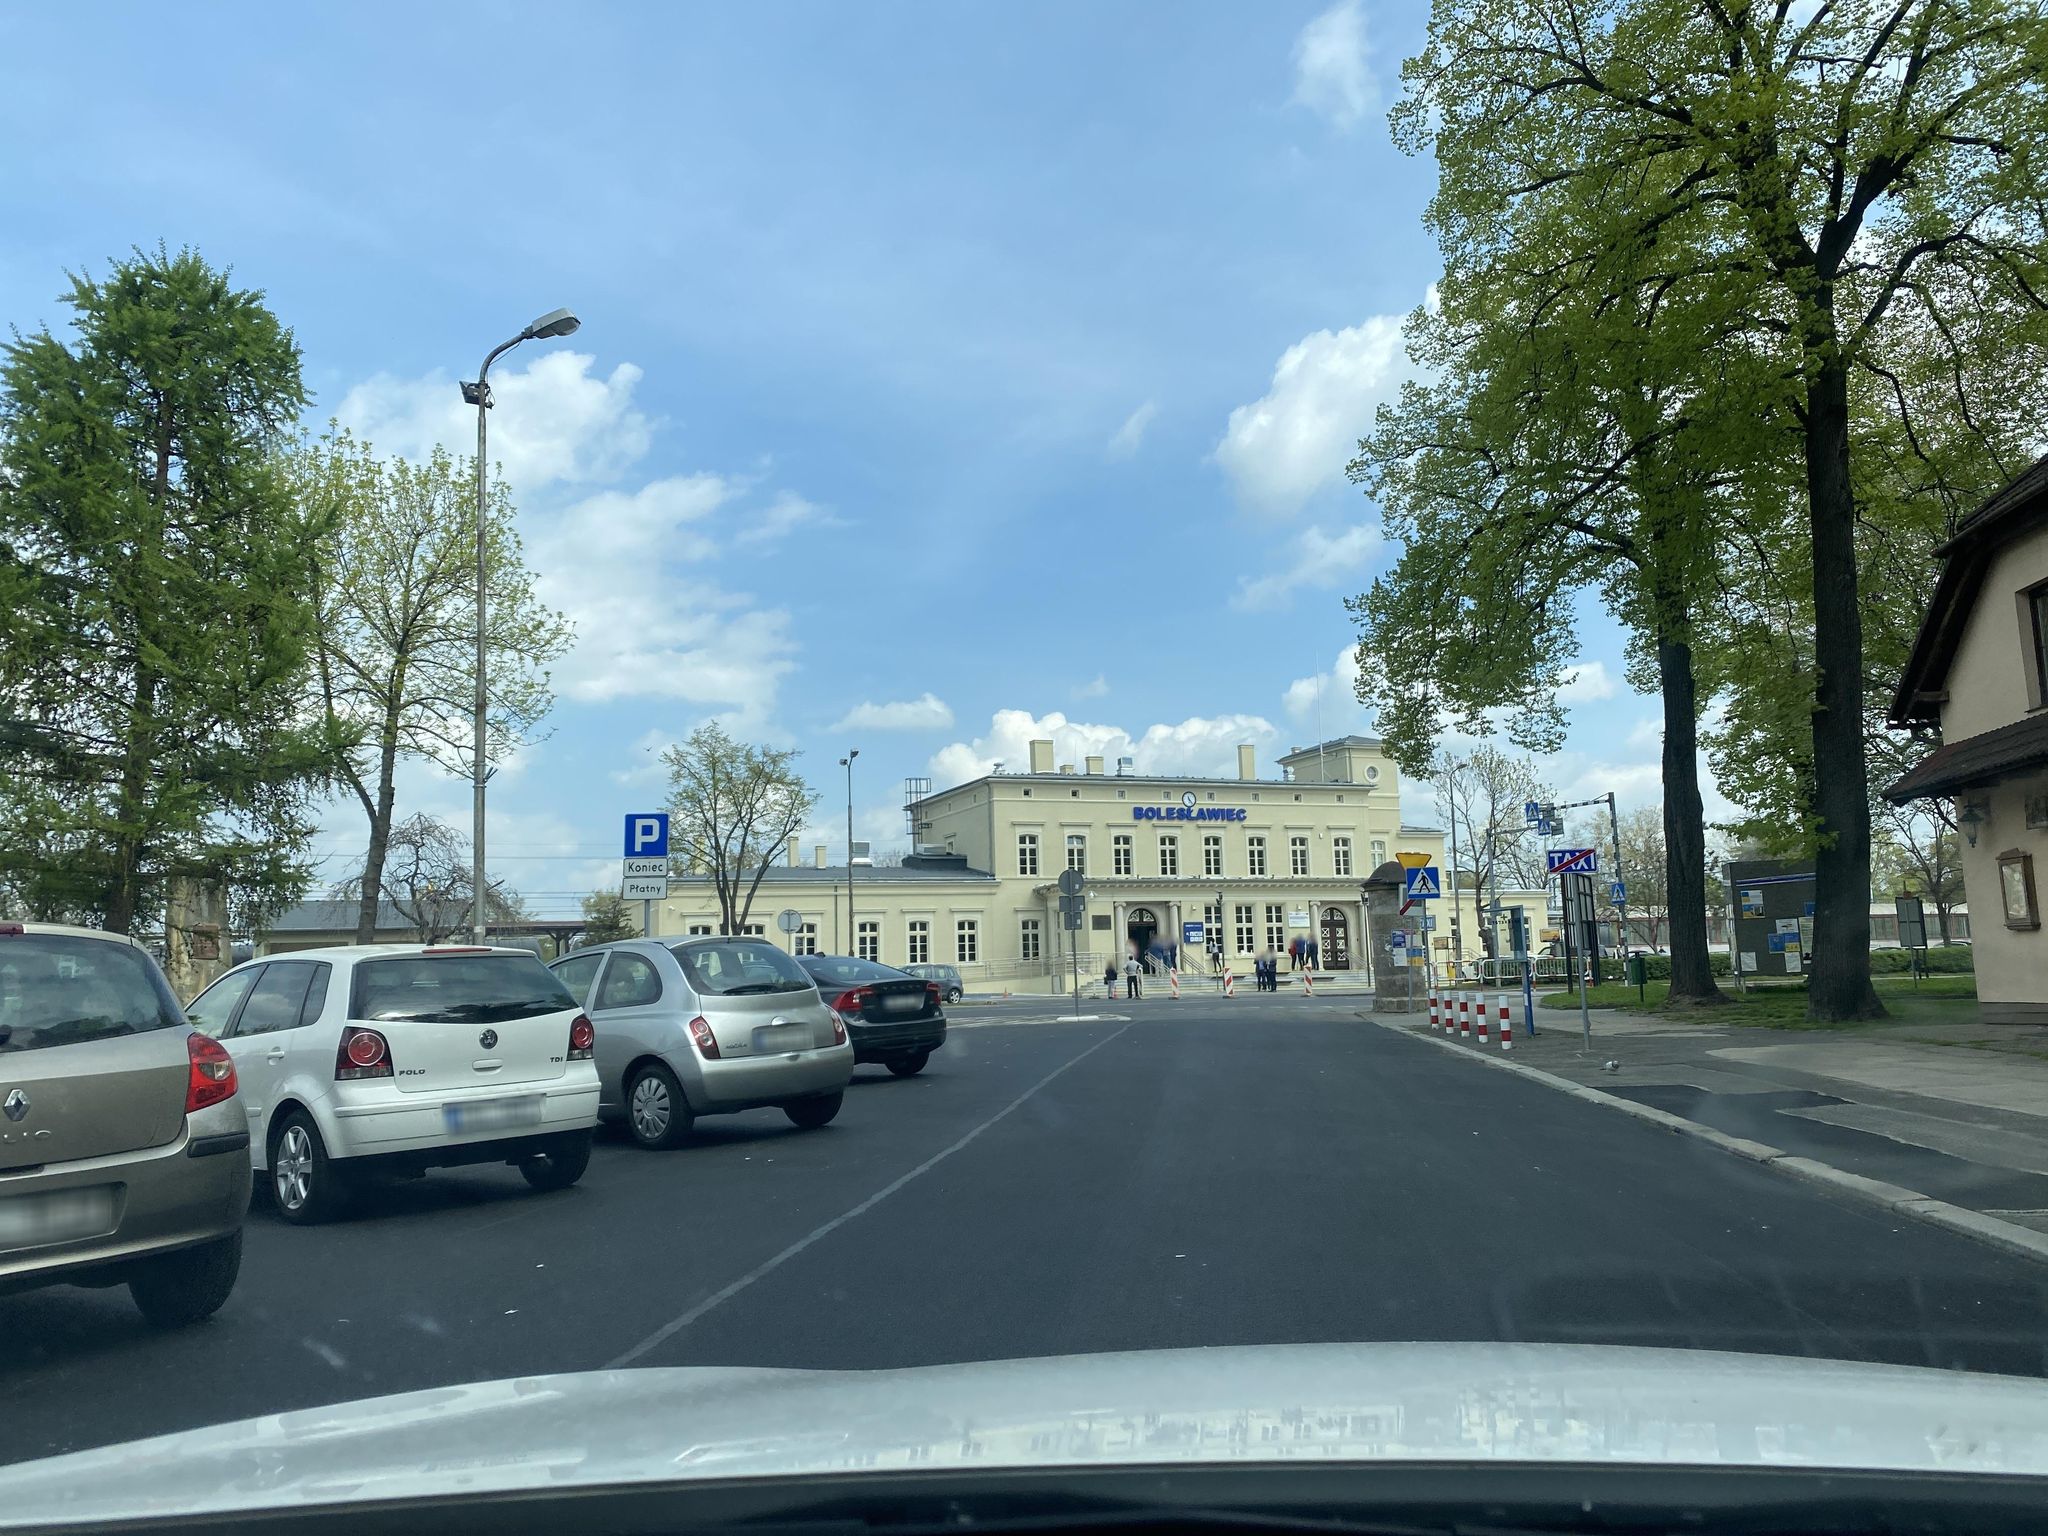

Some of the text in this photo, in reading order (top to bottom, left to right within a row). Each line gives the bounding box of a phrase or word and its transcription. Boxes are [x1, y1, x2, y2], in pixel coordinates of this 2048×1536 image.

[1133, 807, 1247, 821] BOLESŁAWIEC
[634, 818, 660, 852] P
[628, 862, 663, 872] Koniec
[1550, 852, 1595, 870] TAXI
[629, 884, 661, 894] Płatny
